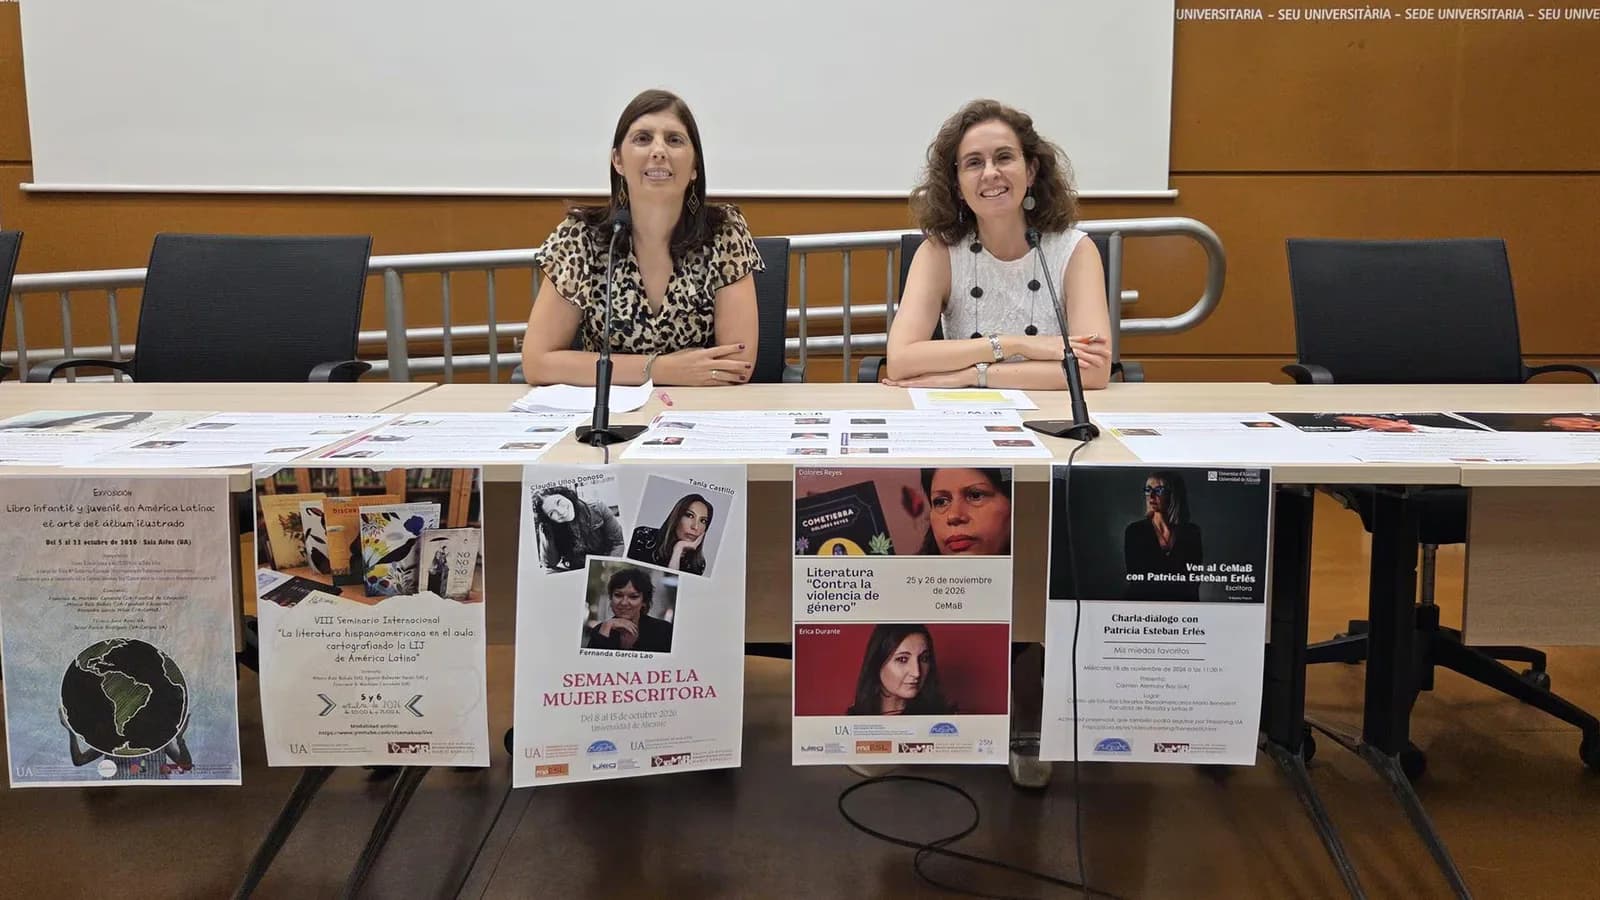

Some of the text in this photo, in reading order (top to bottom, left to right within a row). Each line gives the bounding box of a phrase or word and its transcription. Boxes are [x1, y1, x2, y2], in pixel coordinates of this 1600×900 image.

[1176, 8, 1263, 20] UNIVERSITARIA
[1278, 8, 1300, 20] SEU
[1304, 5, 1392, 20] UNIVERSITÀRIA
[1405, 8, 1434, 20] SEDE
[1438, 8, 1524, 20] UNIVERSITARIA
[1538, 8, 1561, 20] SEU
[577, 473, 604, 483] Donoso
[709, 484, 735, 495] Castillo
[6, 504, 31, 513] Libro
[33, 504, 74, 513] infantil
[76, 506, 83, 514] y
[86, 504, 121, 514] juvenil
[138, 504, 178, 512] América
[802, 508, 854, 527] COMETIERRA
[42, 520, 54, 528] el
[57, 520, 81, 528] arte
[83, 520, 100, 528] del
[136, 520, 185, 528] ilustrado
[807, 567, 874, 578] Literatura
[1186, 563, 1253, 572] Ven al CeMaB
[906, 576, 993, 586] 25 y 26 de noviembre
[1126, 572, 1256, 583] con Patricia Esteban Erlés
[860, 578, 872, 589] la
[807, 590, 880, 601] violencia de
[933, 587, 966, 595] de 2026
[935, 602, 963, 610] CeMaB
[314, 616, 440, 624] VIII Seminario Internacional
[295, 628, 341, 638] literatura
[344, 628, 426, 640] hispanoamericana
[443, 628, 451, 637] el
[1103, 626, 1140, 634] Patricia
[1143, 627, 1179, 635] Esteban
[326, 640, 425, 653] cartografiando la LIJ
[334, 653, 345, 662] de
[348, 653, 385, 662] América
[579, 649, 613, 657] Fernanda
[563, 668, 699, 688] SEMANA DE LA
[376, 693, 382, 701] 6
[543, 685, 717, 707] MUJER ESCRITORA
[834, 725, 850, 736] UA
[289, 743, 308, 754] UA
[630, 740, 645, 750] UA
[525, 747, 541, 758] UA
